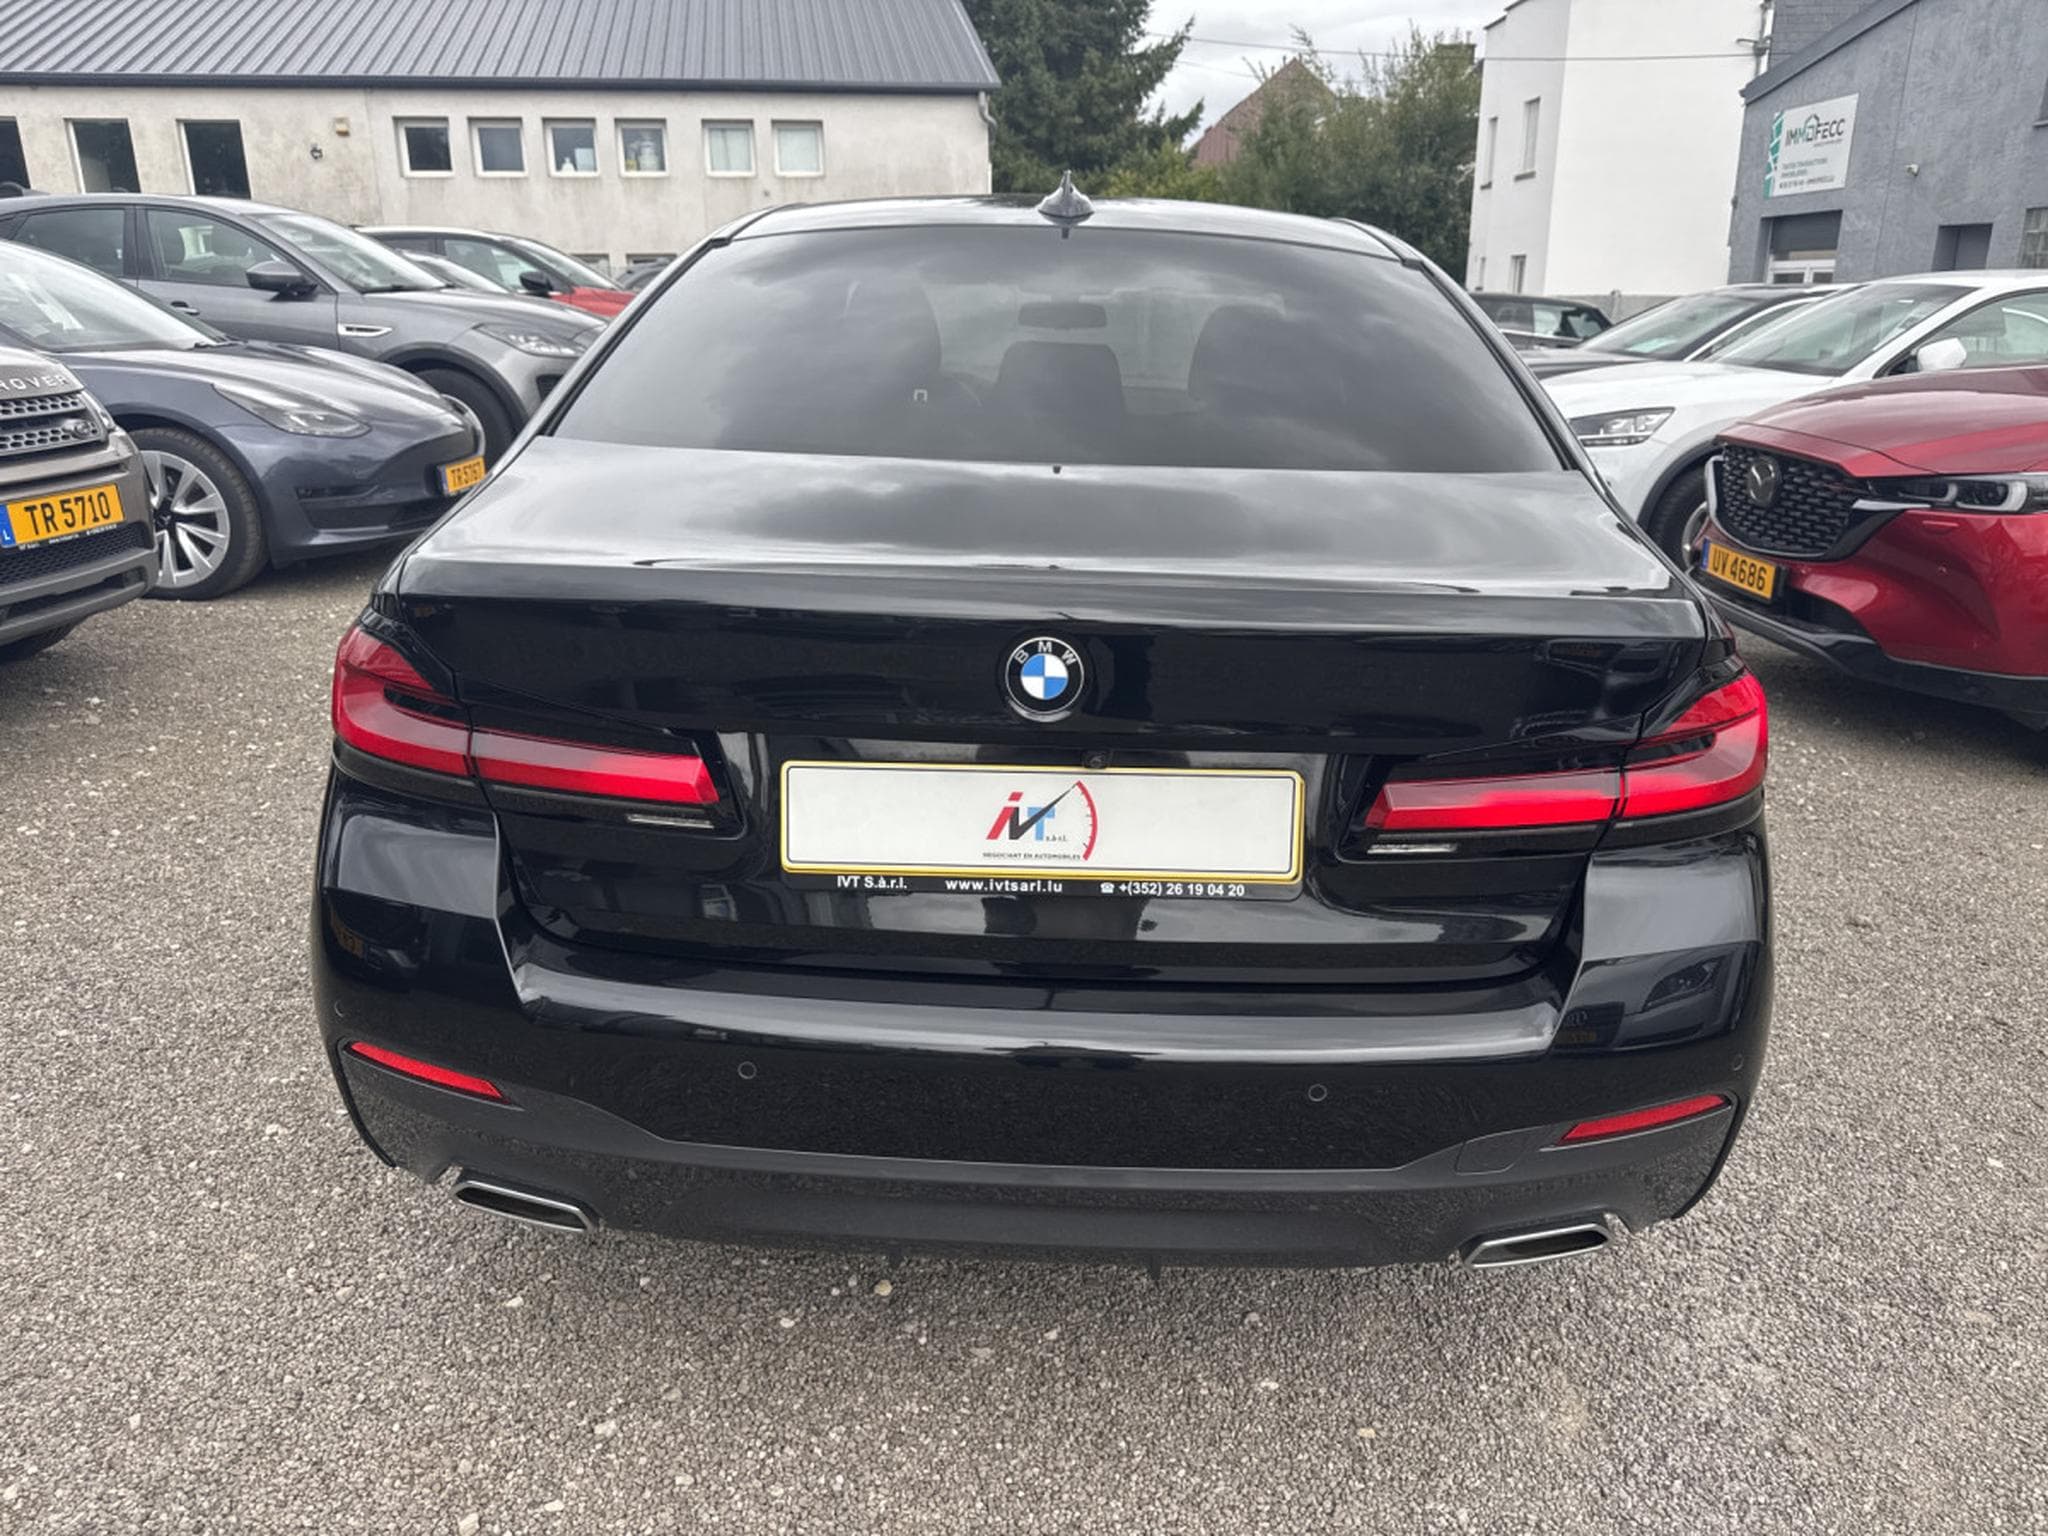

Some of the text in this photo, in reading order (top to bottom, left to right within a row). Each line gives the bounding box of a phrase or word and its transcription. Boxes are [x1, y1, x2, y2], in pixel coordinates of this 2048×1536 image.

[24, 491, 111, 536] TR 5710
[2, 529, 11, 541] L
[1712, 547, 1767, 591] UV 4686
[1014, 641, 1077, 666] BMW
[837, 875, 860, 888] IVT
[945, 878, 1063, 893] www.ivtsarl.lu
[1166, 882, 1183, 896] 26
[1187, 883, 1203, 896] 19
[1207, 883, 1225, 897] 04
[1228, 884, 1245, 897] 20
